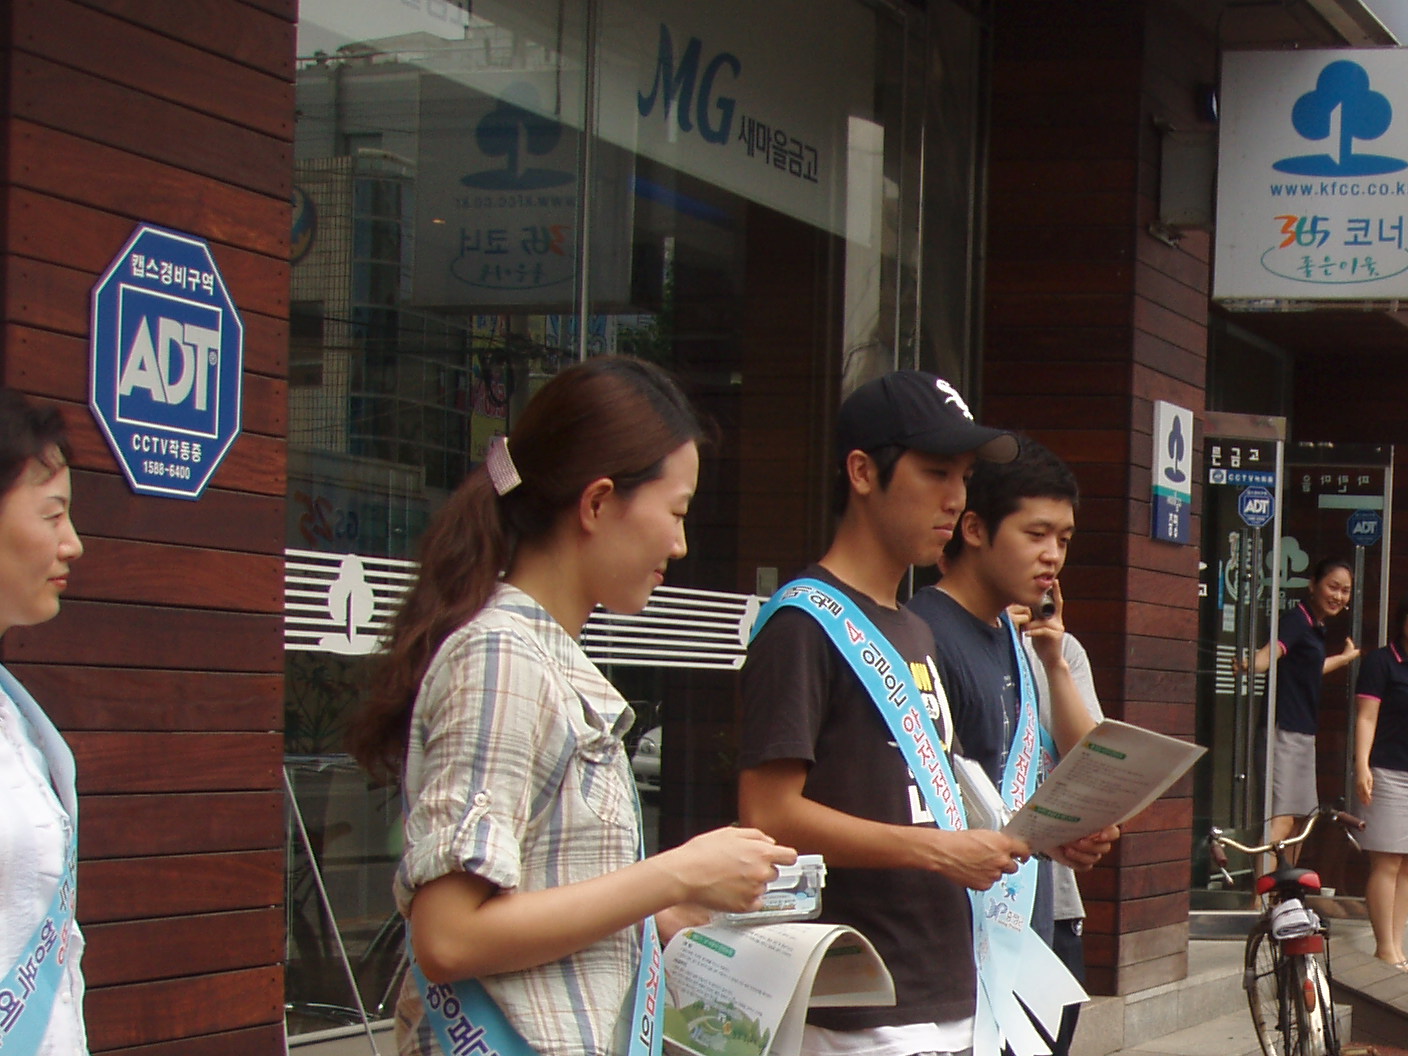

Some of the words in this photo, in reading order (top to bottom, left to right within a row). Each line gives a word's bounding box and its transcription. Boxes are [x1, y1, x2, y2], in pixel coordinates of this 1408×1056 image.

[637, 22, 742, 145] MG
[738, 115, 819, 184] 새마을금고
[1273, 215, 1330, 250] 365
[1344, 216, 1404, 250] 코너
[131, 253, 215, 296] 캡스경비구역
[119, 315, 219, 411] ADT
[132, 433, 203, 463] CCTV작동중
[143, 460, 191, 480] 1588-6400
[1244, 499, 1269, 514] ADT
[1353, 520, 1378, 534] ADT
[845, 617, 866, 644] 4
